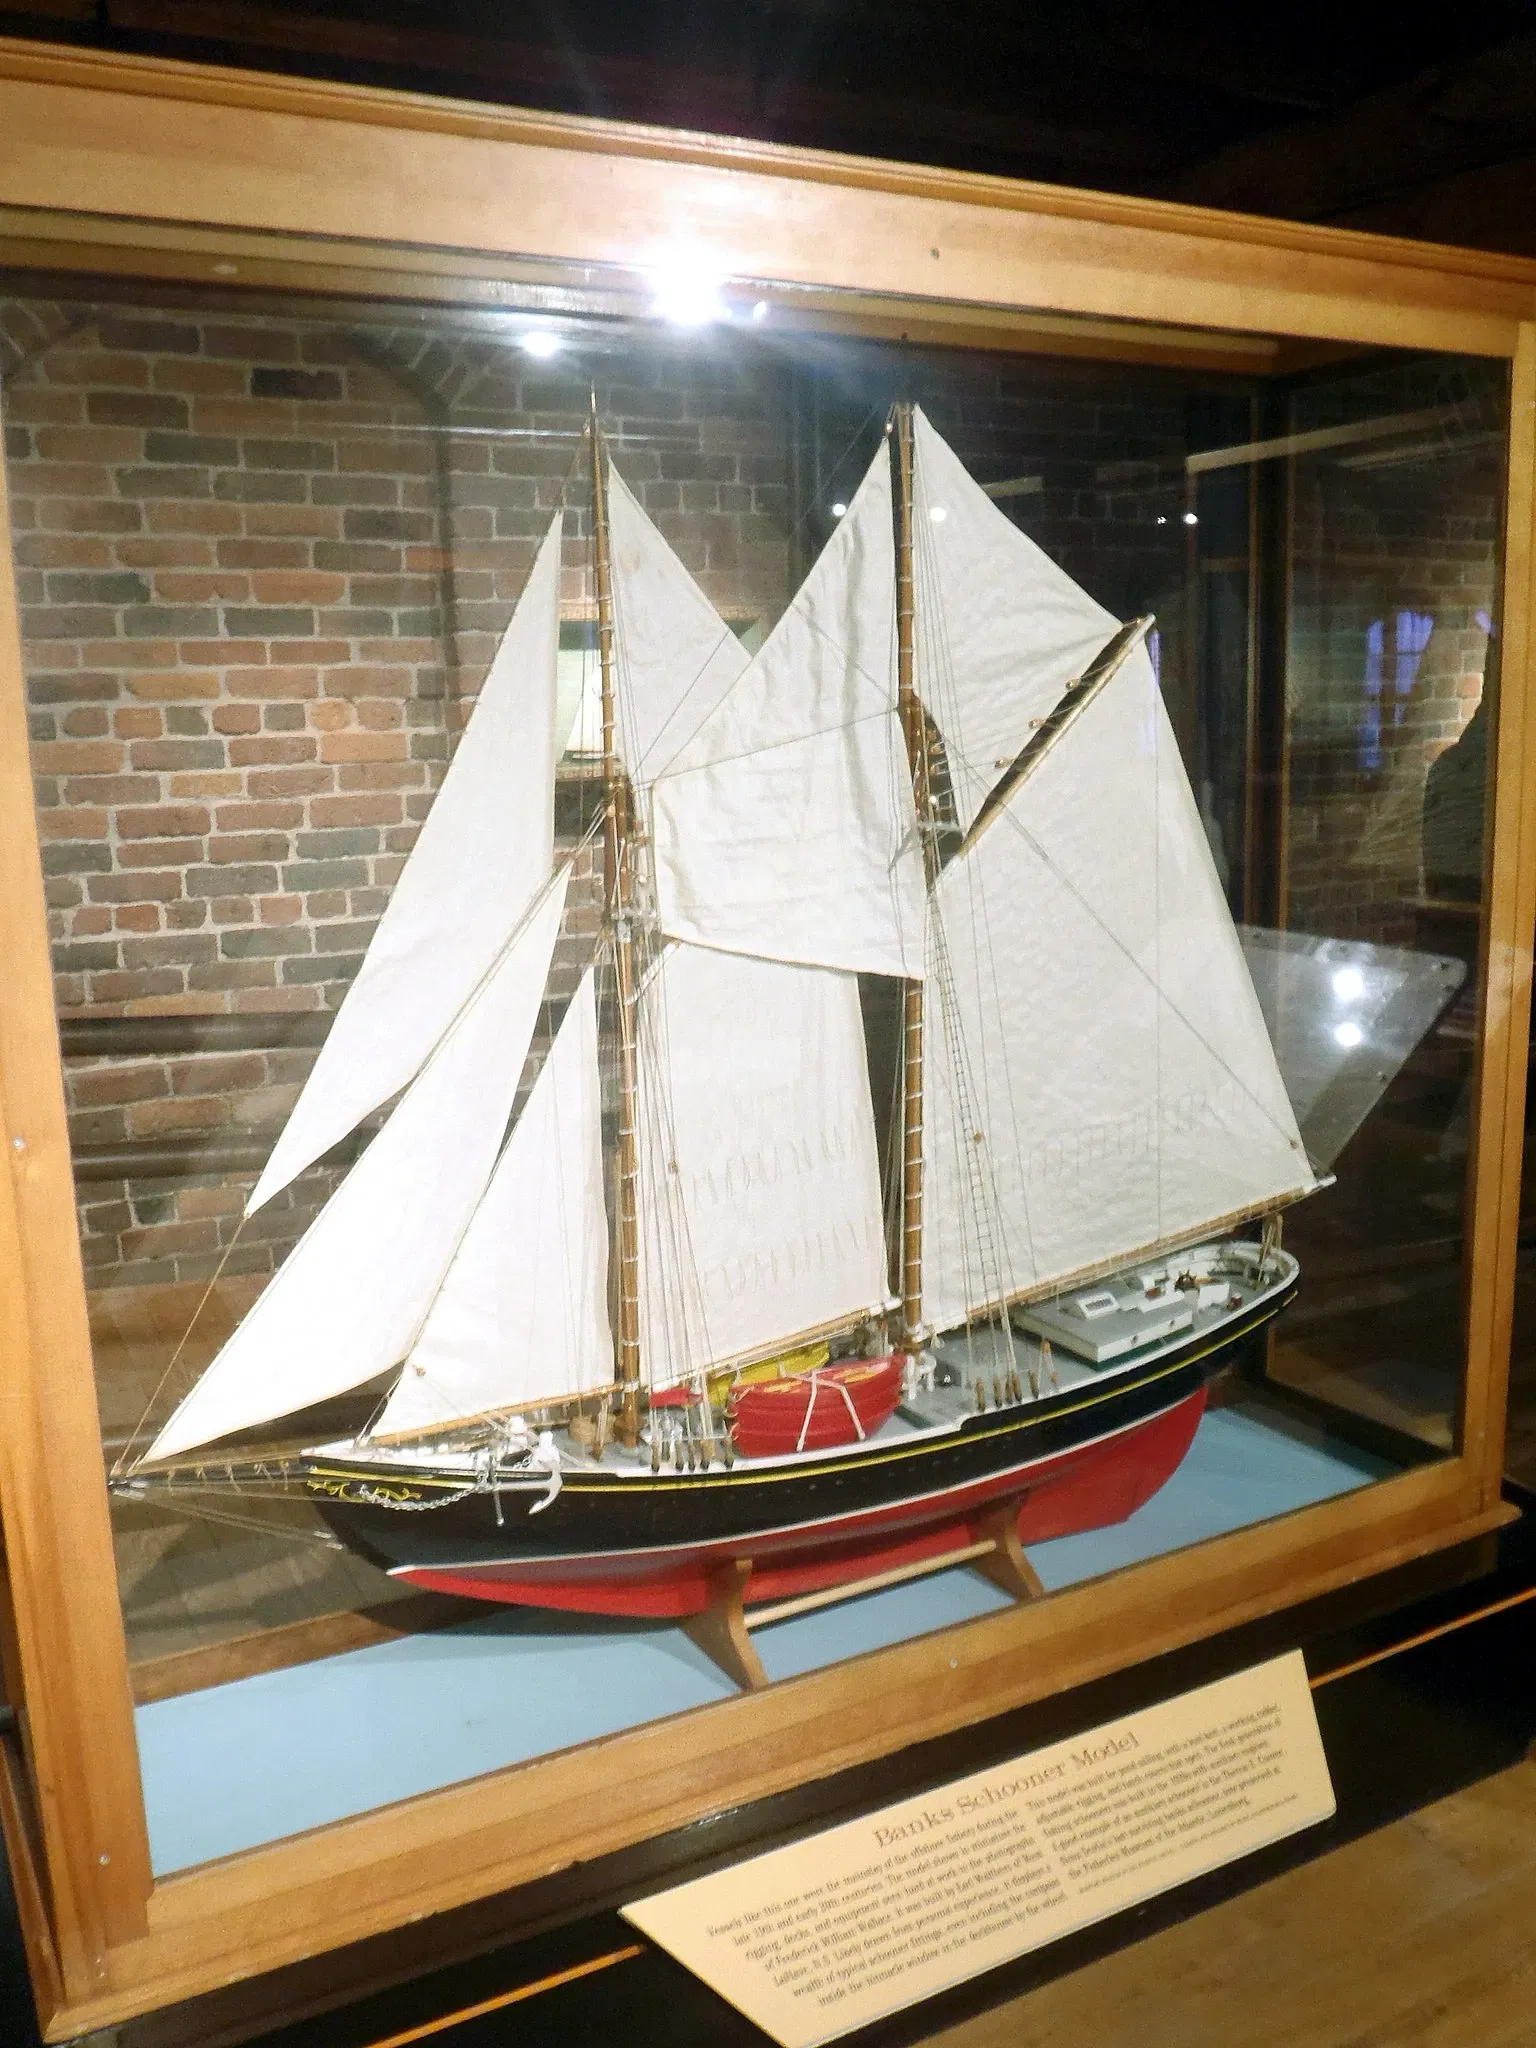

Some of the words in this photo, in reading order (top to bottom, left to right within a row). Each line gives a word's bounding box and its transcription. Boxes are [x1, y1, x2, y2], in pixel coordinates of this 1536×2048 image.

[872, 1806, 955, 1848] Banks
[955, 1763, 1067, 1816] Schooner
[1069, 1728, 1141, 1771] Model
